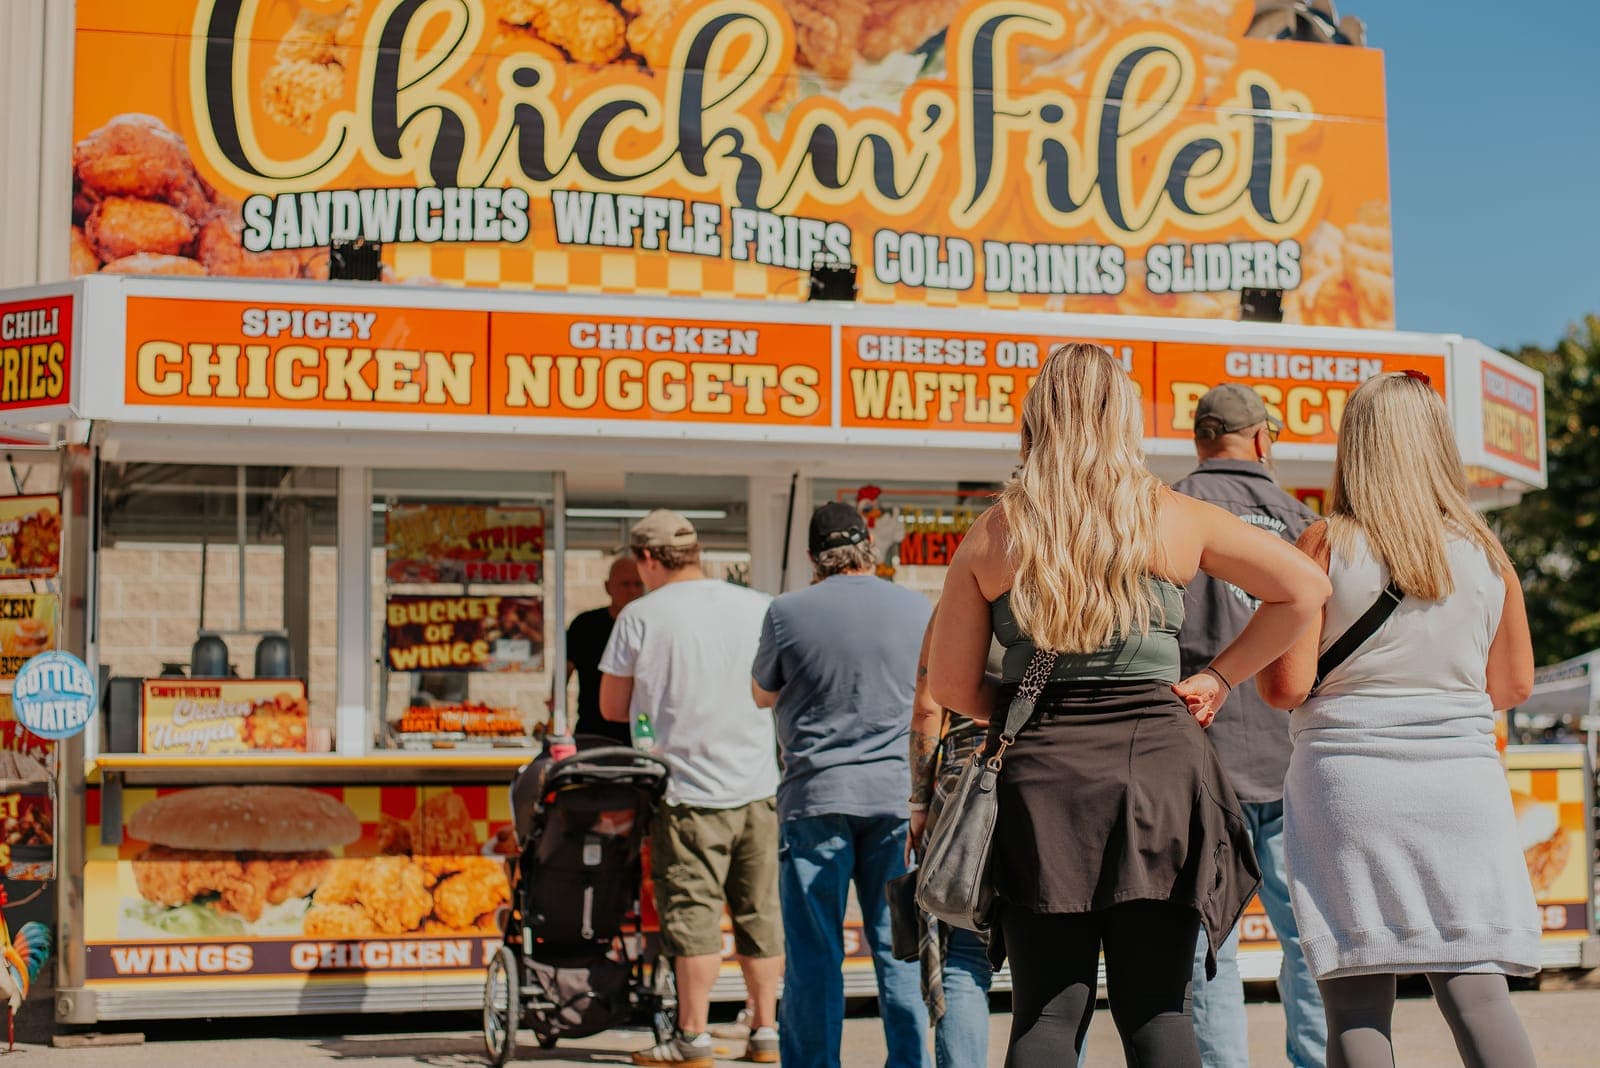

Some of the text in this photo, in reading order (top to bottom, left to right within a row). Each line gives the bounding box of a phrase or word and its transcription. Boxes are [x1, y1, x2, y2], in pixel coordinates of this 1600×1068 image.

[243, 187, 1302, 295] SANDWICHES WAFFLE FRIES COLD DRINKS SLIDERS
[2, 307, 60, 341] CHILI
[242, 308, 377, 340] SPICEY
[569, 322, 760, 357] CHICKEN
[857, 335, 987, 366] CHEESE
[995, 341, 1039, 368] OR
[1225, 351, 1384, 382] CHICKEN
[0, 341, 65, 402] RIES
[136, 340, 476, 406] CHICKEN
[504, 354, 821, 419] NUGGETS
[849, 368, 1014, 424] WAFFLE
[387, 597, 502, 627] BUCKET
[424, 624, 455, 642] OF
[389, 639, 490, 670] WINGS
[16, 661, 92, 699] BOTTLED
[21, 699, 89, 733] WATER
[111, 944, 254, 975] WINGS
[290, 940, 473, 971] CHICKEN
